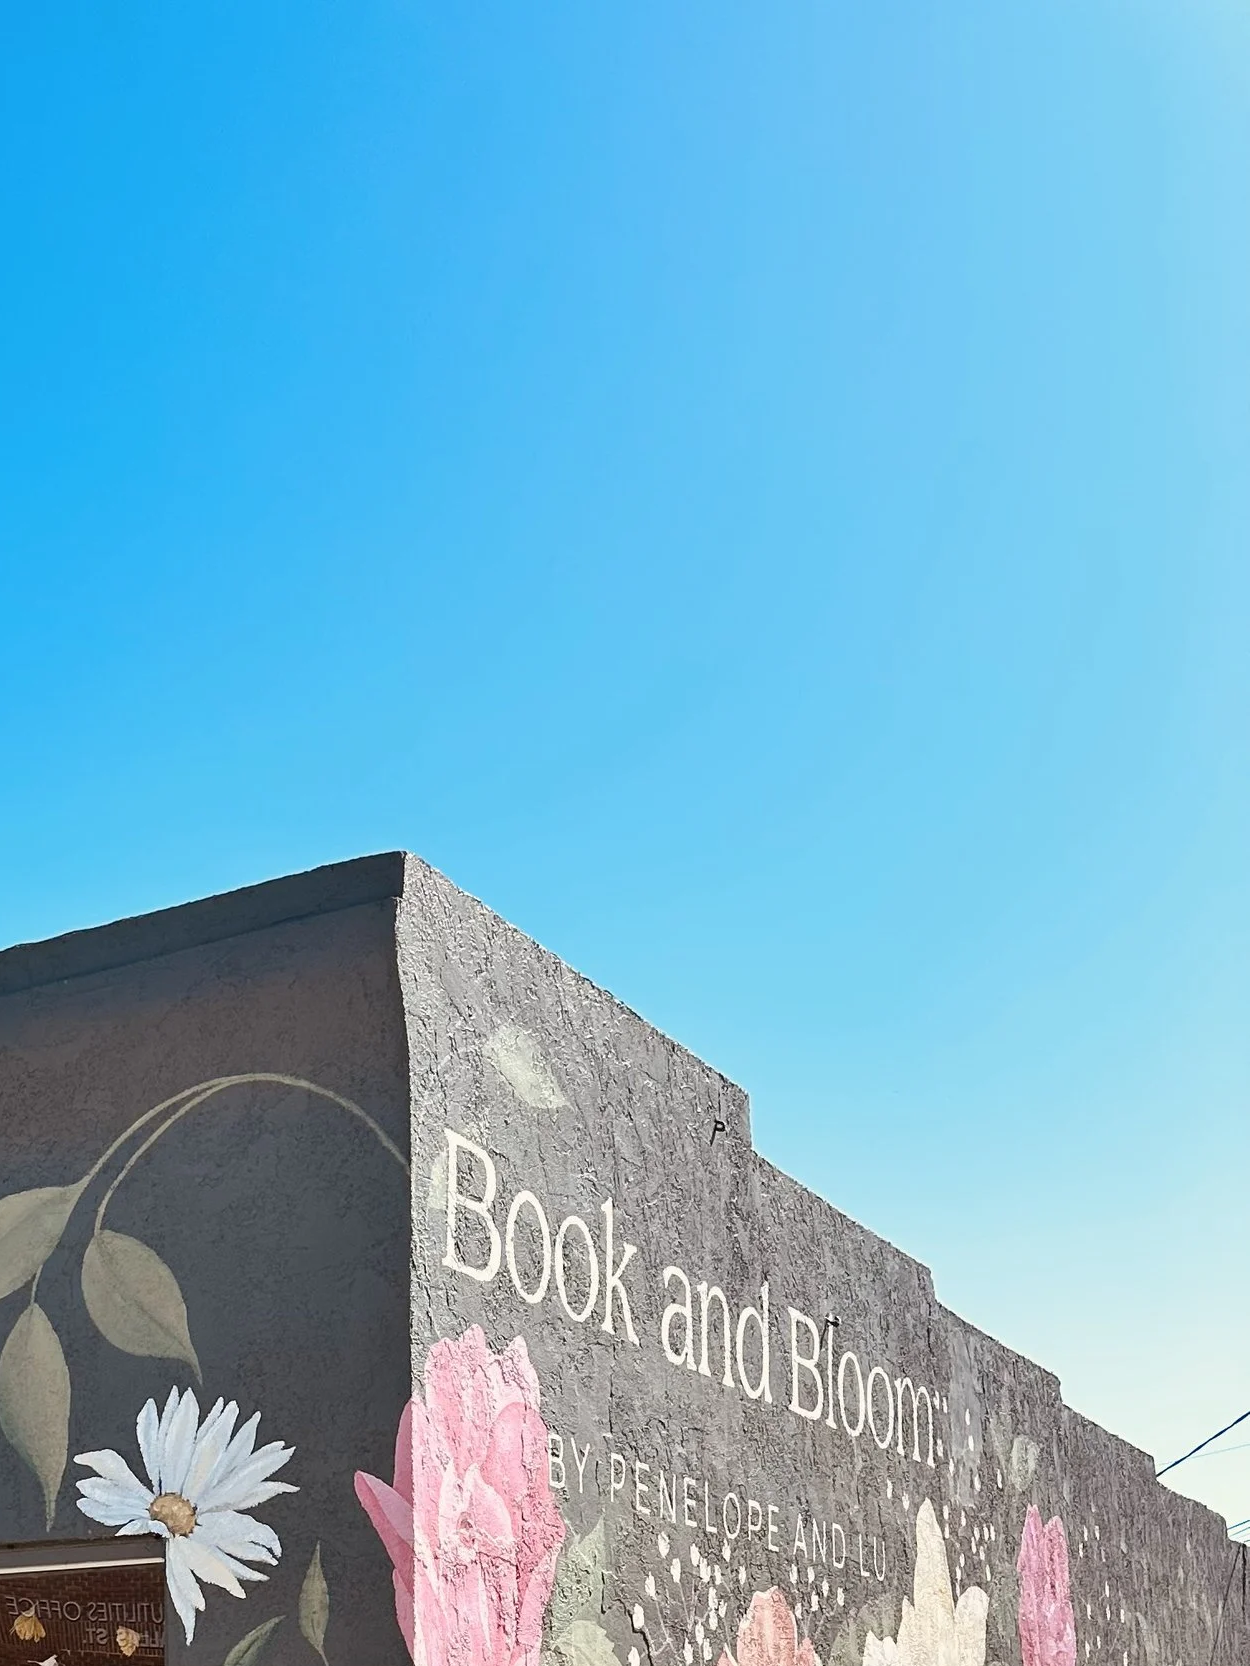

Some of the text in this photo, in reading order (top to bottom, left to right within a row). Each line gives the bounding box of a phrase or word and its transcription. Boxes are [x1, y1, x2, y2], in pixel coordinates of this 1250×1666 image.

[442, 1127, 936, 1470] Book and Bloom
[548, 1433, 886, 1581] BY PENELOPE AND LU
